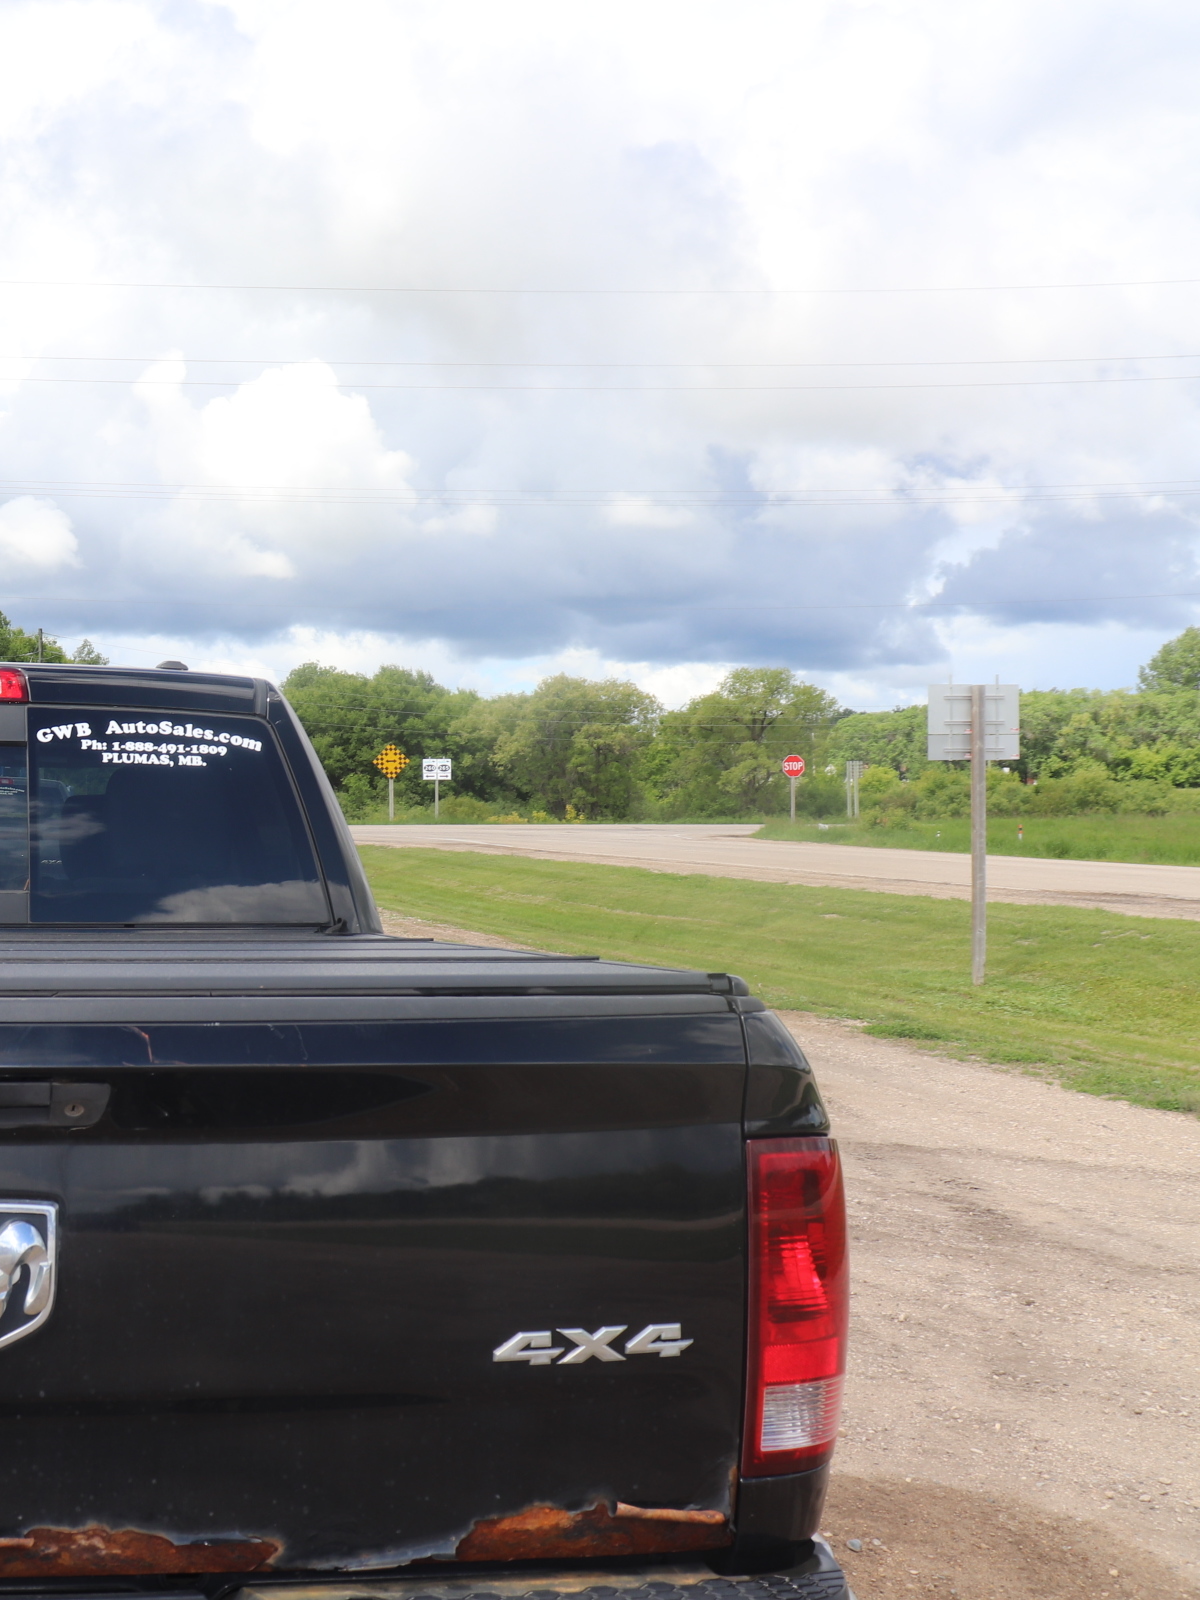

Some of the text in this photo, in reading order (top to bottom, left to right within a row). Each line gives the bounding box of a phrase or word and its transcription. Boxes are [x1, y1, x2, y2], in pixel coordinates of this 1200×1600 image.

[36, 720, 262, 752] GWB AutoSales.com
[81, 739, 227, 756] Ph: 1-888-491-1809
[102, 752, 207, 767] PLUMAS, MB.
[784, 761, 803, 771] STOP
[492, 1323, 694, 1365] 4X4
